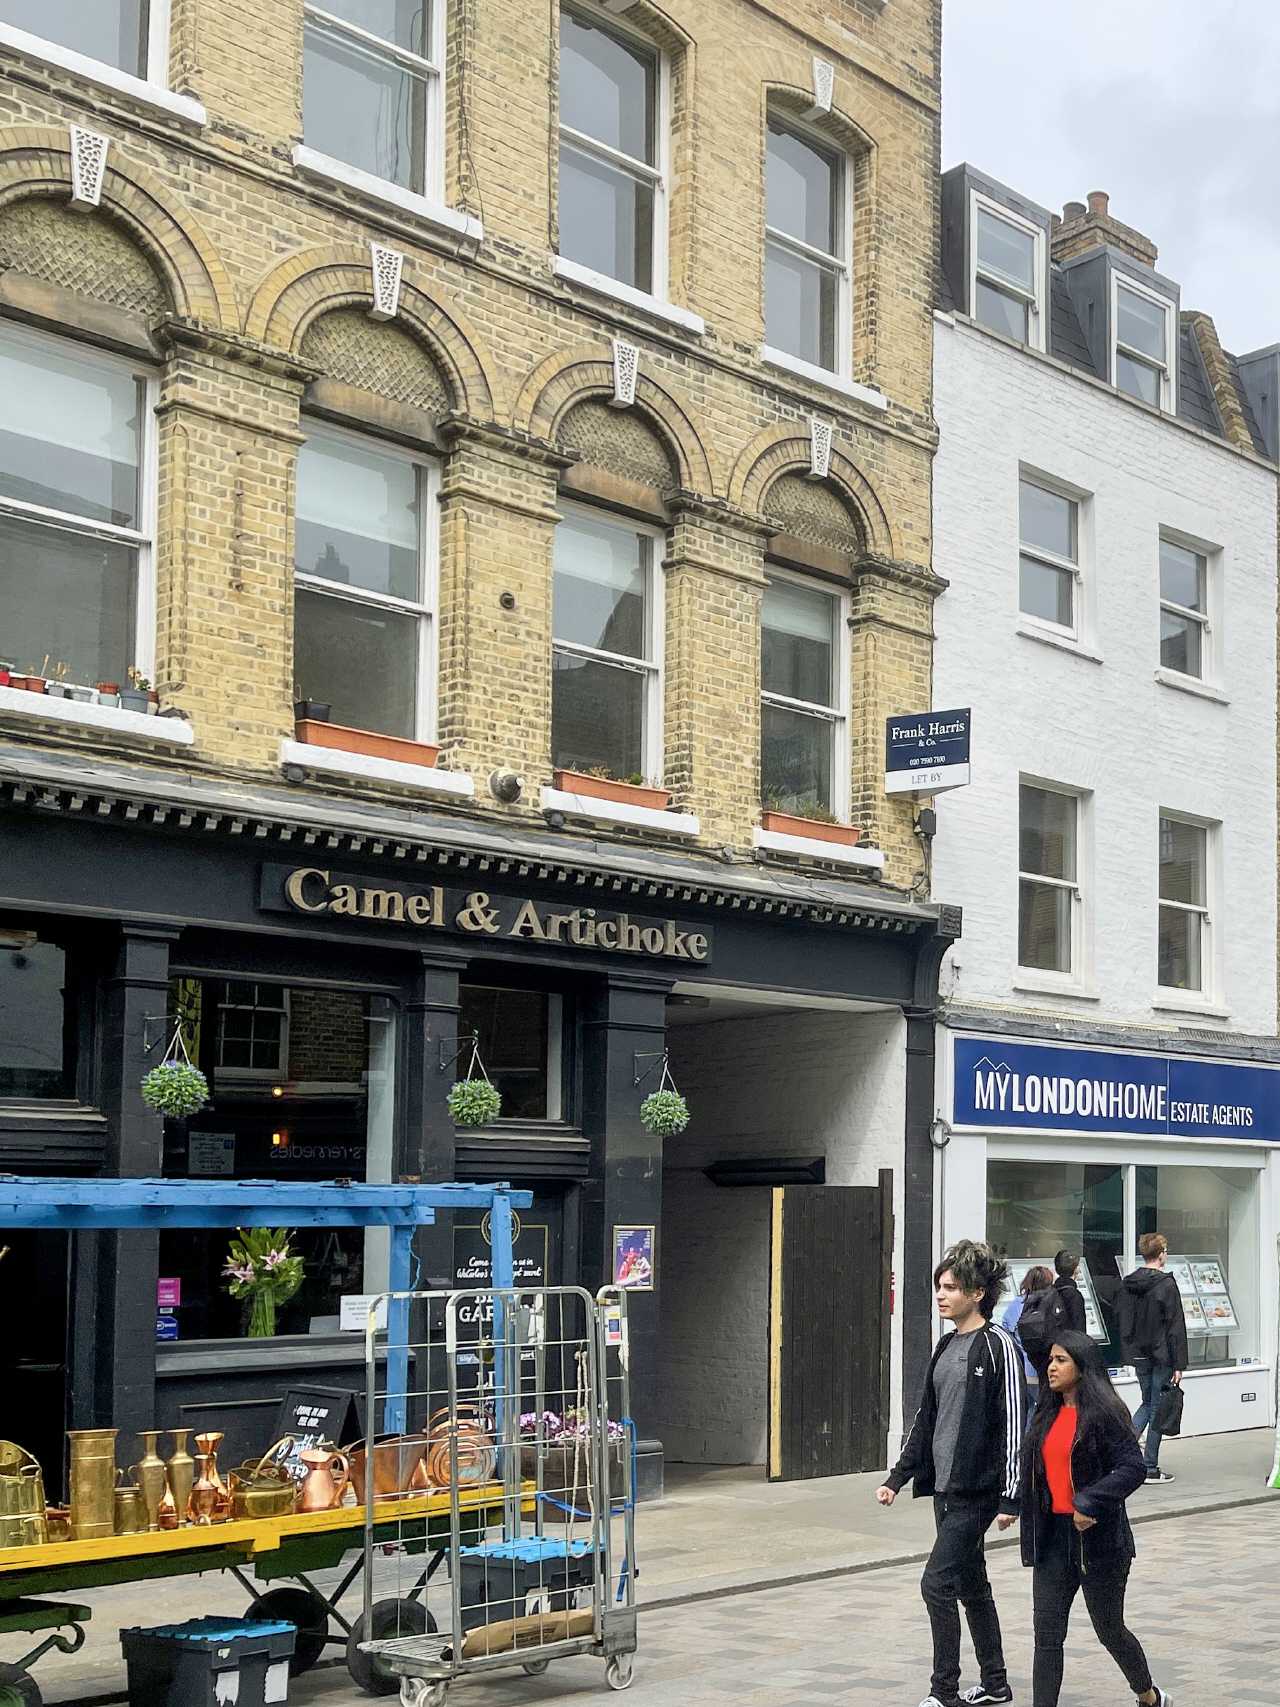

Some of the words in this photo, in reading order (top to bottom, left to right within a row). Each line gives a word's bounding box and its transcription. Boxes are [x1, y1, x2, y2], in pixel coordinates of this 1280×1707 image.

[891, 724, 925, 740] Frank
[928, 720, 965, 735] Harris
[918, 739, 925, 747] &
[912, 774, 927, 785] LET
[286, 868, 446, 927] Camel
[456, 891, 501, 934] &
[508, 899, 709, 961] Artichoke
[974, 1070, 1167, 1121] MYLONDONHOME
[1170, 1101, 1209, 1125] ESTATE
[1212, 1104, 1253, 1127] AGENTS
